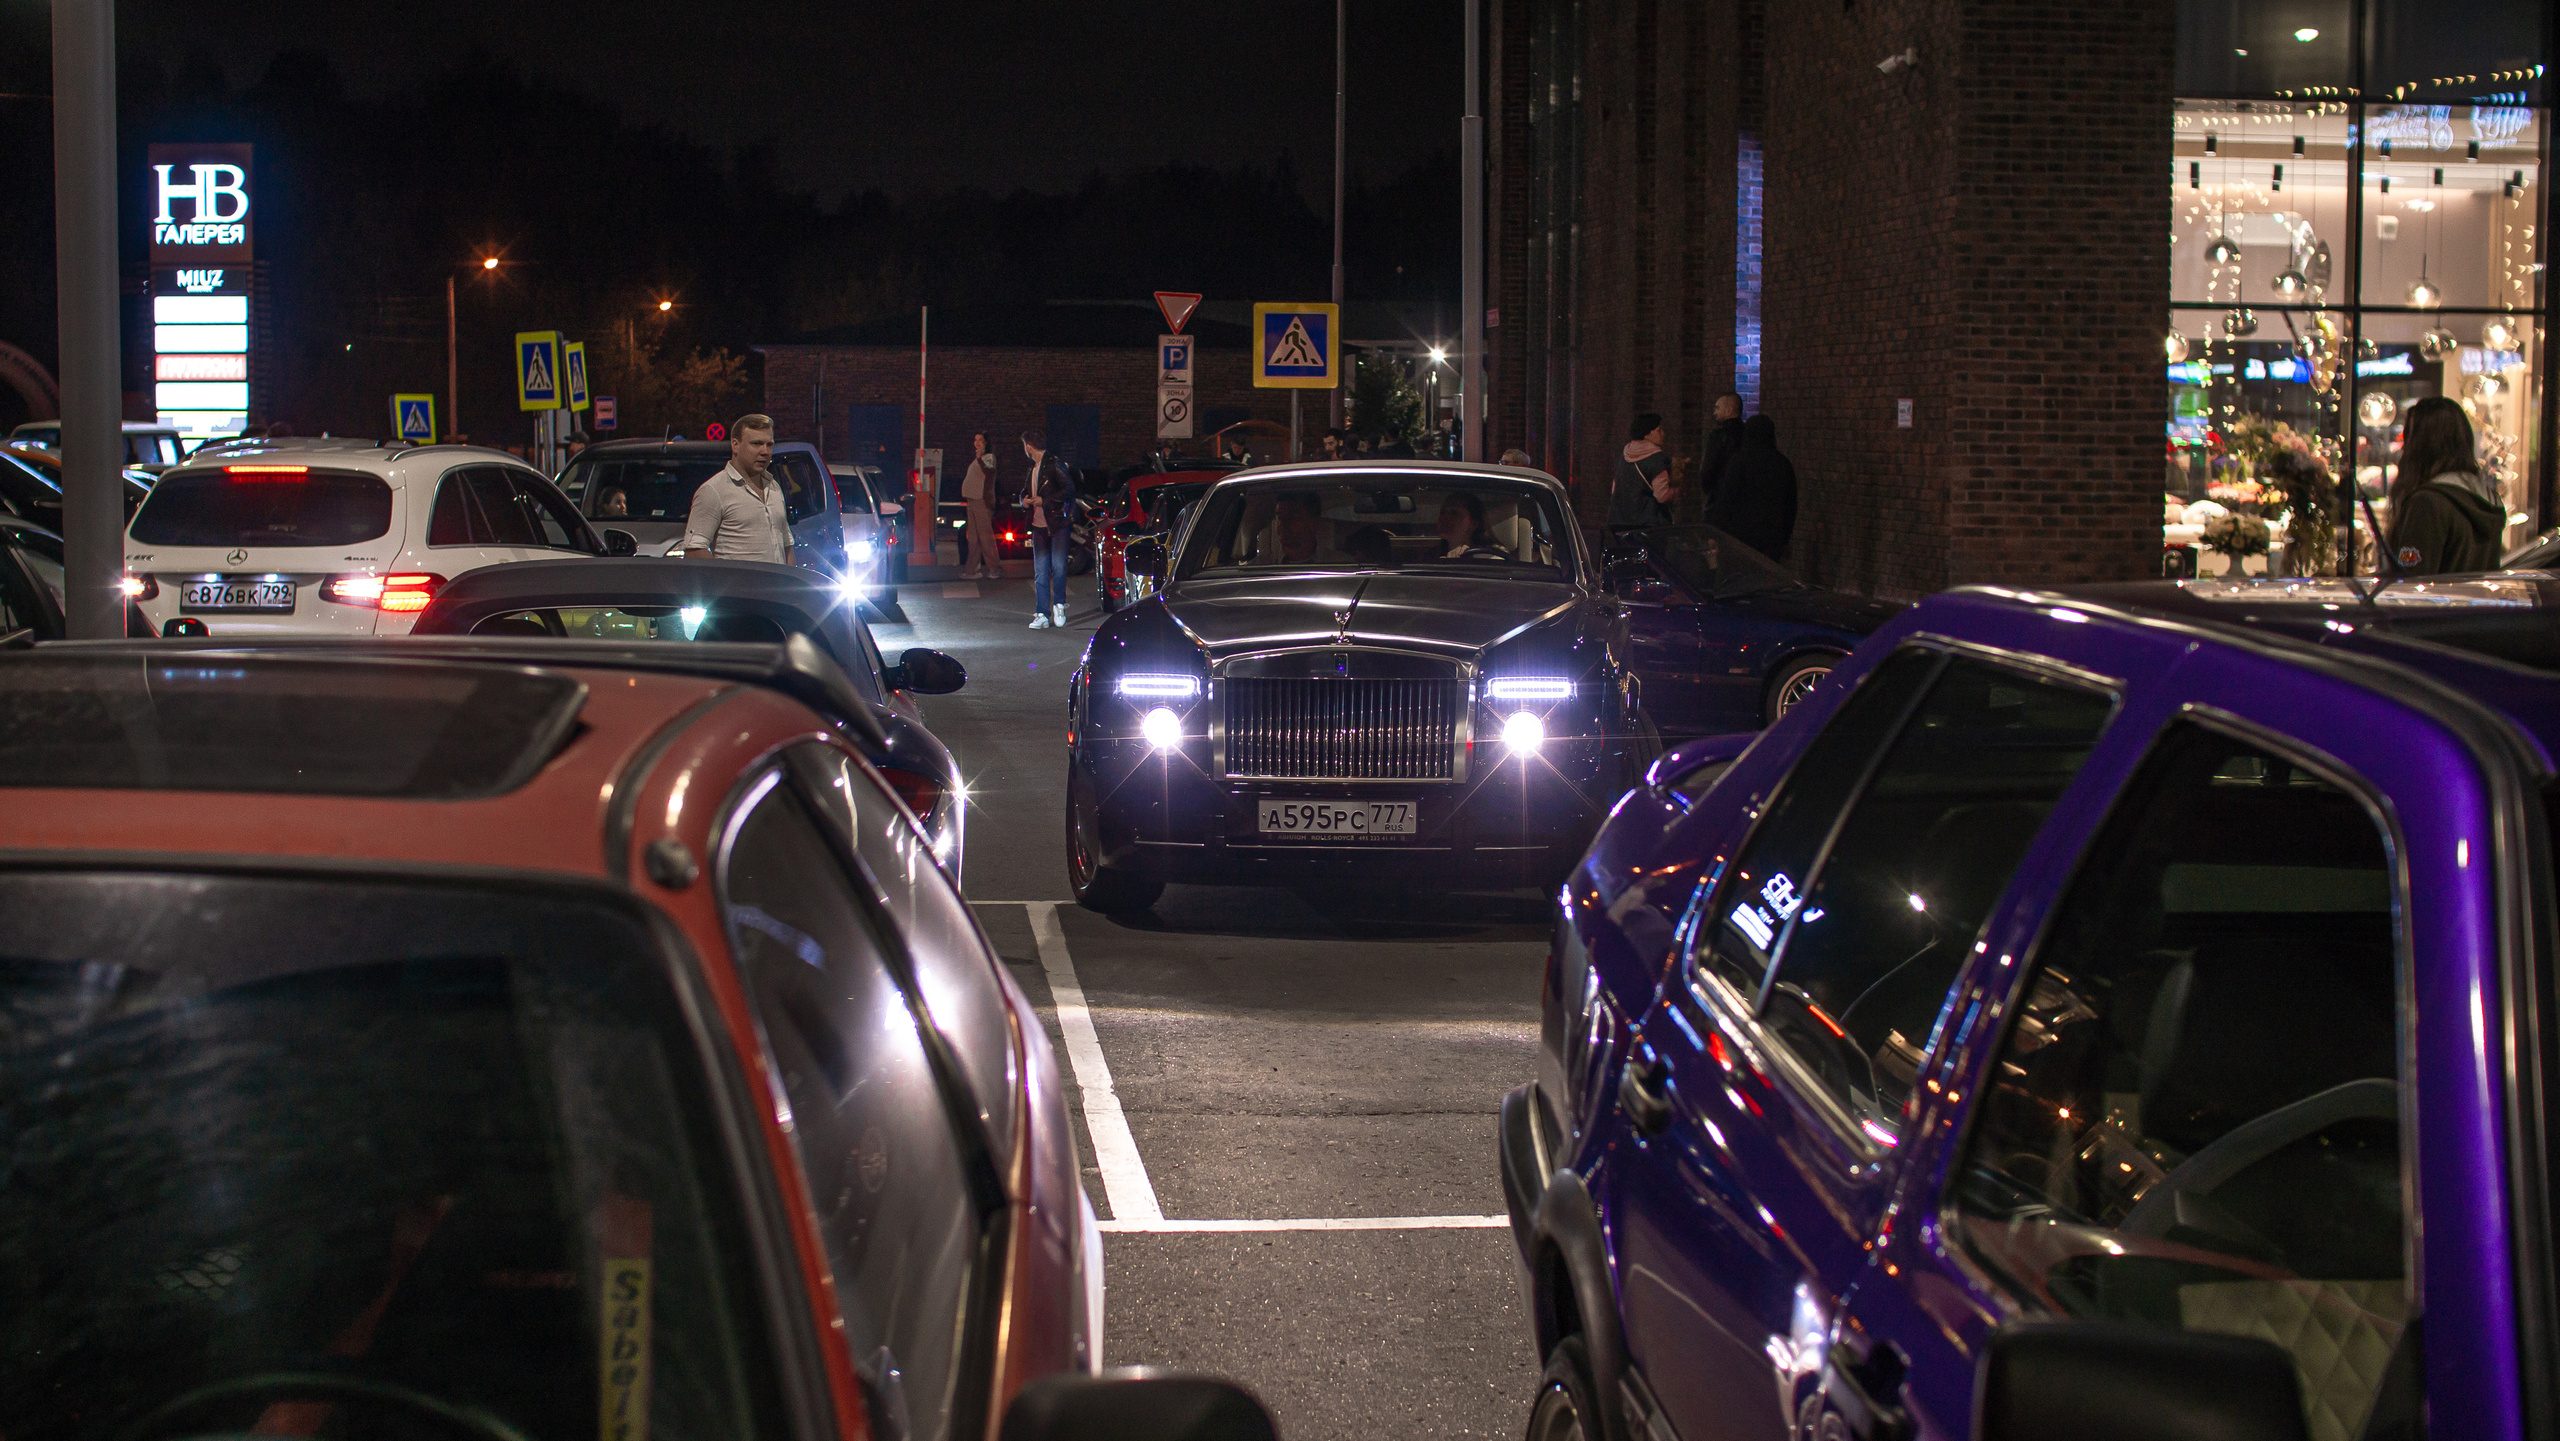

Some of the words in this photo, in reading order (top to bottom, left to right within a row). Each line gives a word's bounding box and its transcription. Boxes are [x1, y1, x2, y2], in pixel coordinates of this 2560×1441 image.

[155, 224, 245, 245] ГАЛЕРЕЯ
[176, 269, 224, 287] MIUZ
[1170, 405, 1181, 415] 10
[263, 585, 289, 599] 799
[1371, 804, 1408, 823] 777
[1384, 824, 1404, 832] RUS
